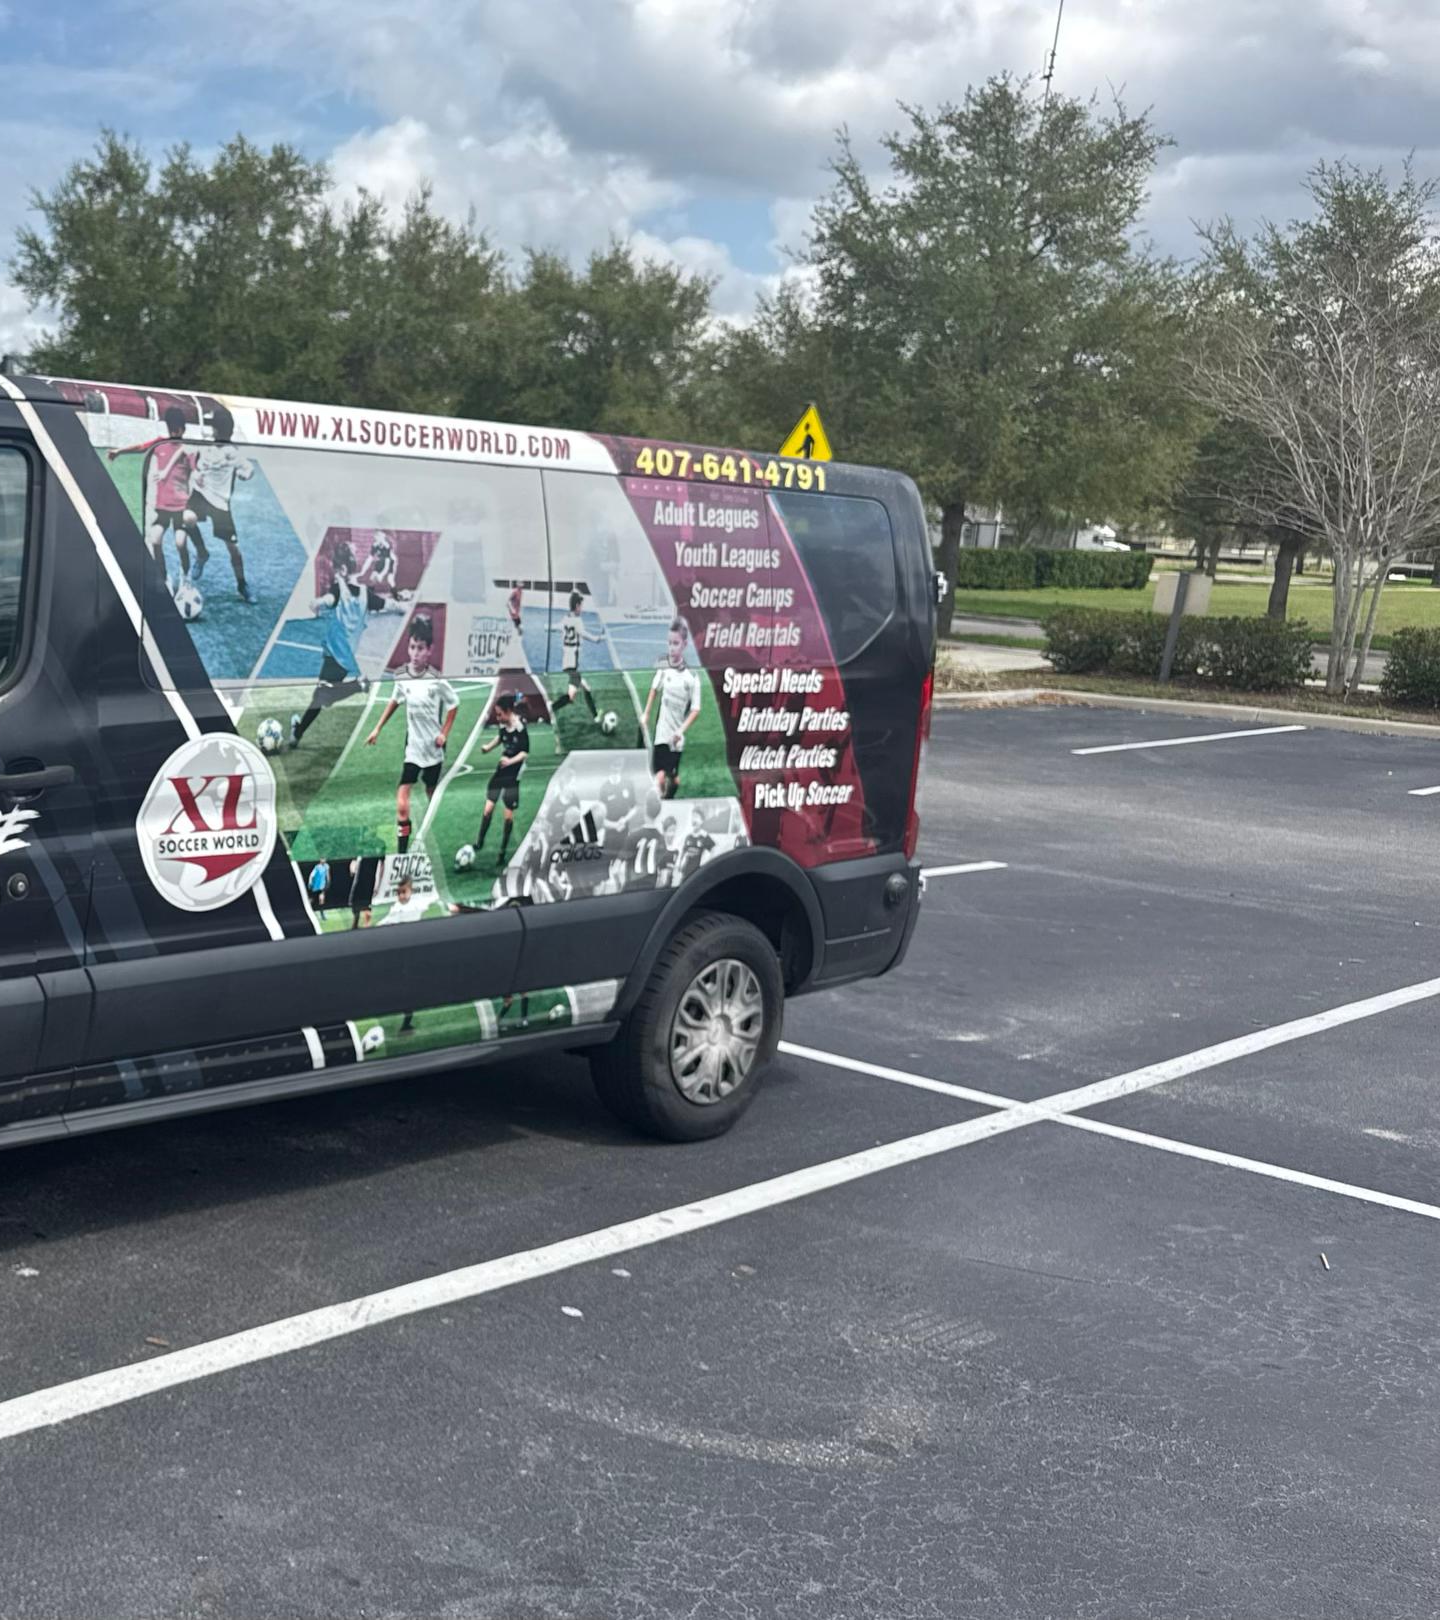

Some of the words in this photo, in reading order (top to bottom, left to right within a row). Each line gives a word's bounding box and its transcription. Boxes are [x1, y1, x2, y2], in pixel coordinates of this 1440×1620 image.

[256, 409, 570, 459] WWW.XLSOCCERWORLD.COM
[636, 447, 826, 491] 407-641-4791
[654, 501, 695, 526] Adult
[698, 502, 759, 532] Leagues
[675, 541, 717, 567] Youth
[721, 543, 780, 572] Leagues
[690, 582, 744, 608] Soccer
[746, 583, 794, 612] Camps
[704, 623, 743, 648] Field
[745, 622, 801, 648] Rentals
[723, 668, 777, 697] Special
[779, 668, 824, 694] Needs
[737, 707, 799, 736] Birthday
[799, 706, 850, 732] Parties
[739, 745, 786, 771] Watch
[786, 744, 837, 769] Parties
[160, 773, 258, 836] XL
[755, 783, 787, 809] Pick
[788, 782, 806, 811] Up
[805, 781, 853, 804] Soccer
[159, 838, 208, 854] SOCCER
[213, 834, 260, 850] WORLD
[550, 842, 605, 864] adidas
